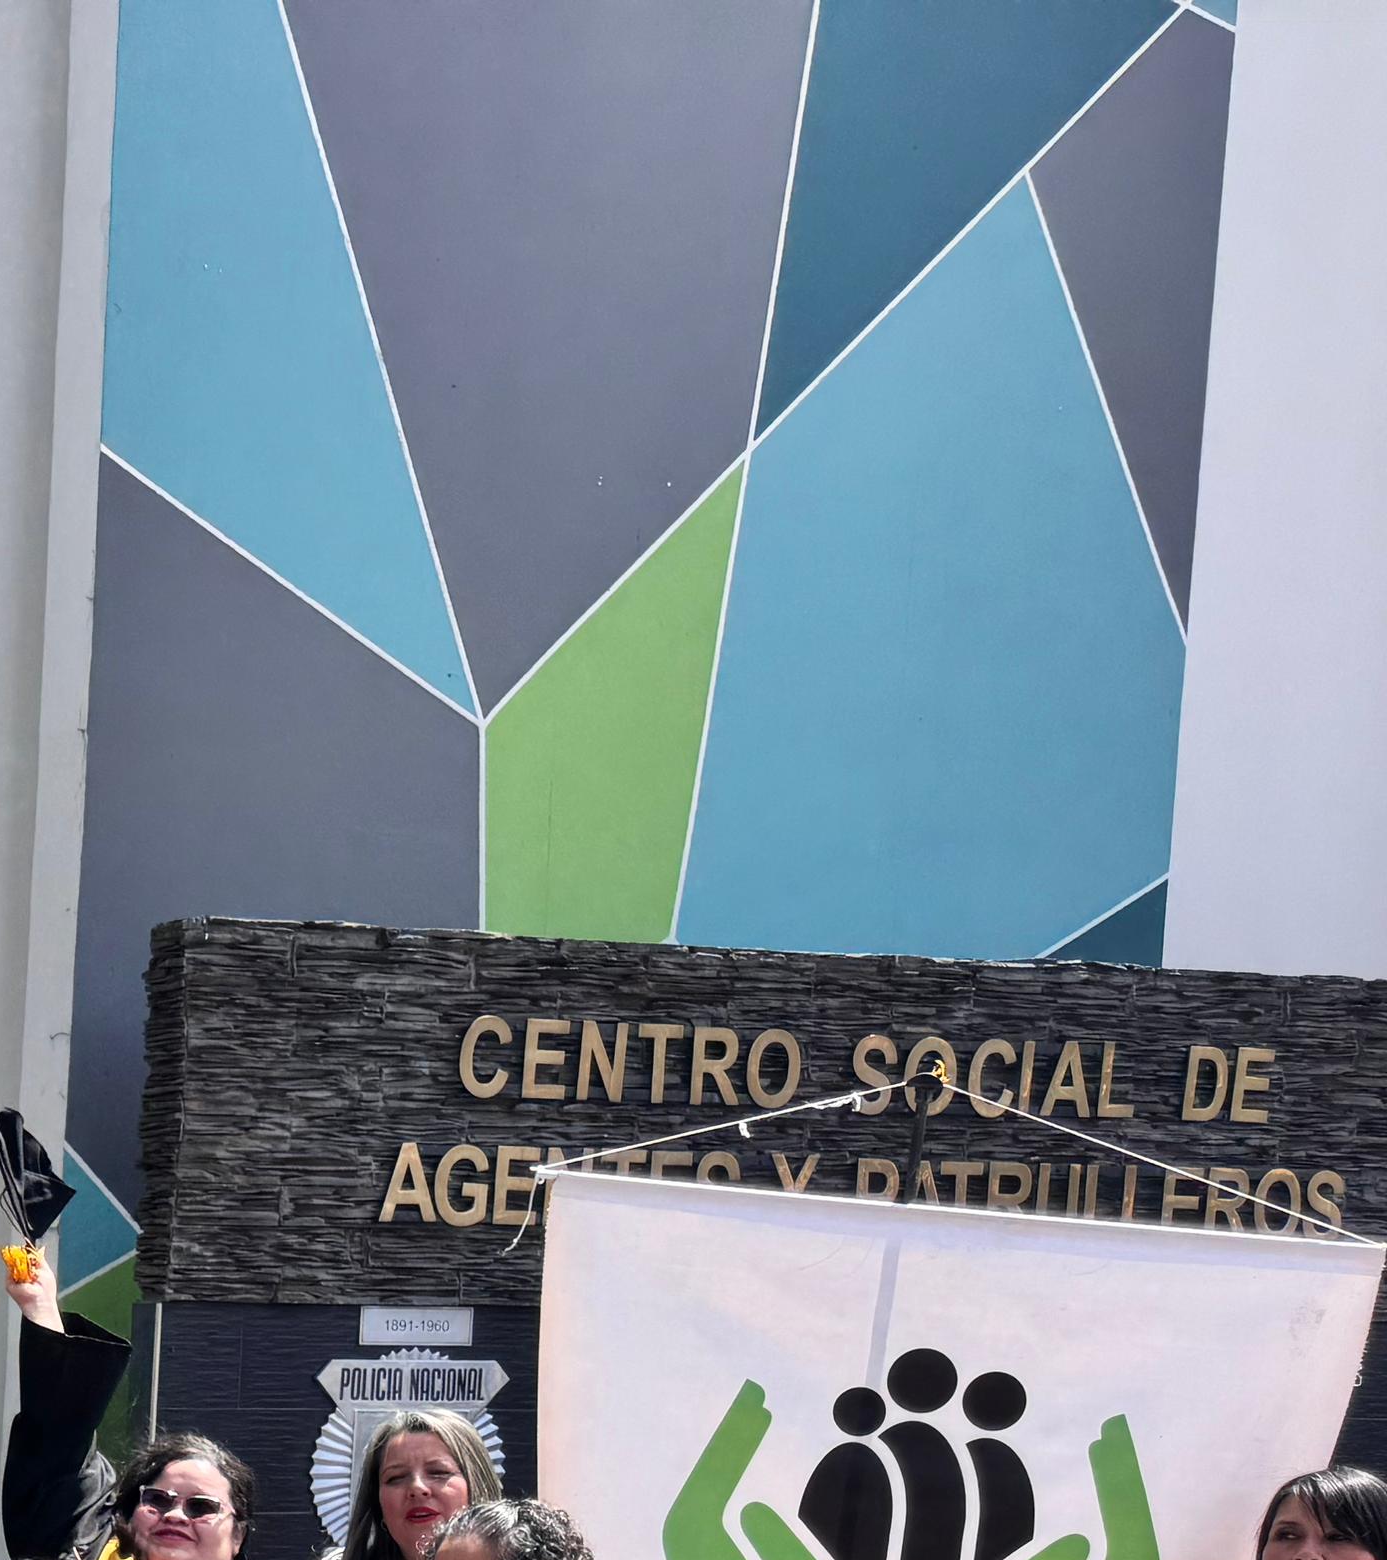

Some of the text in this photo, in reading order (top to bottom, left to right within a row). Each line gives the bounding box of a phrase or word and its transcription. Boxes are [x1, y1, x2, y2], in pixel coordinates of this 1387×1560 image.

[459, 1015, 1276, 1123] CENTRO SOCIAL DE
[384, 1319, 451, 1333] 1891-1960
[339, 1367, 485, 1402] POLICIA NACIONAL
